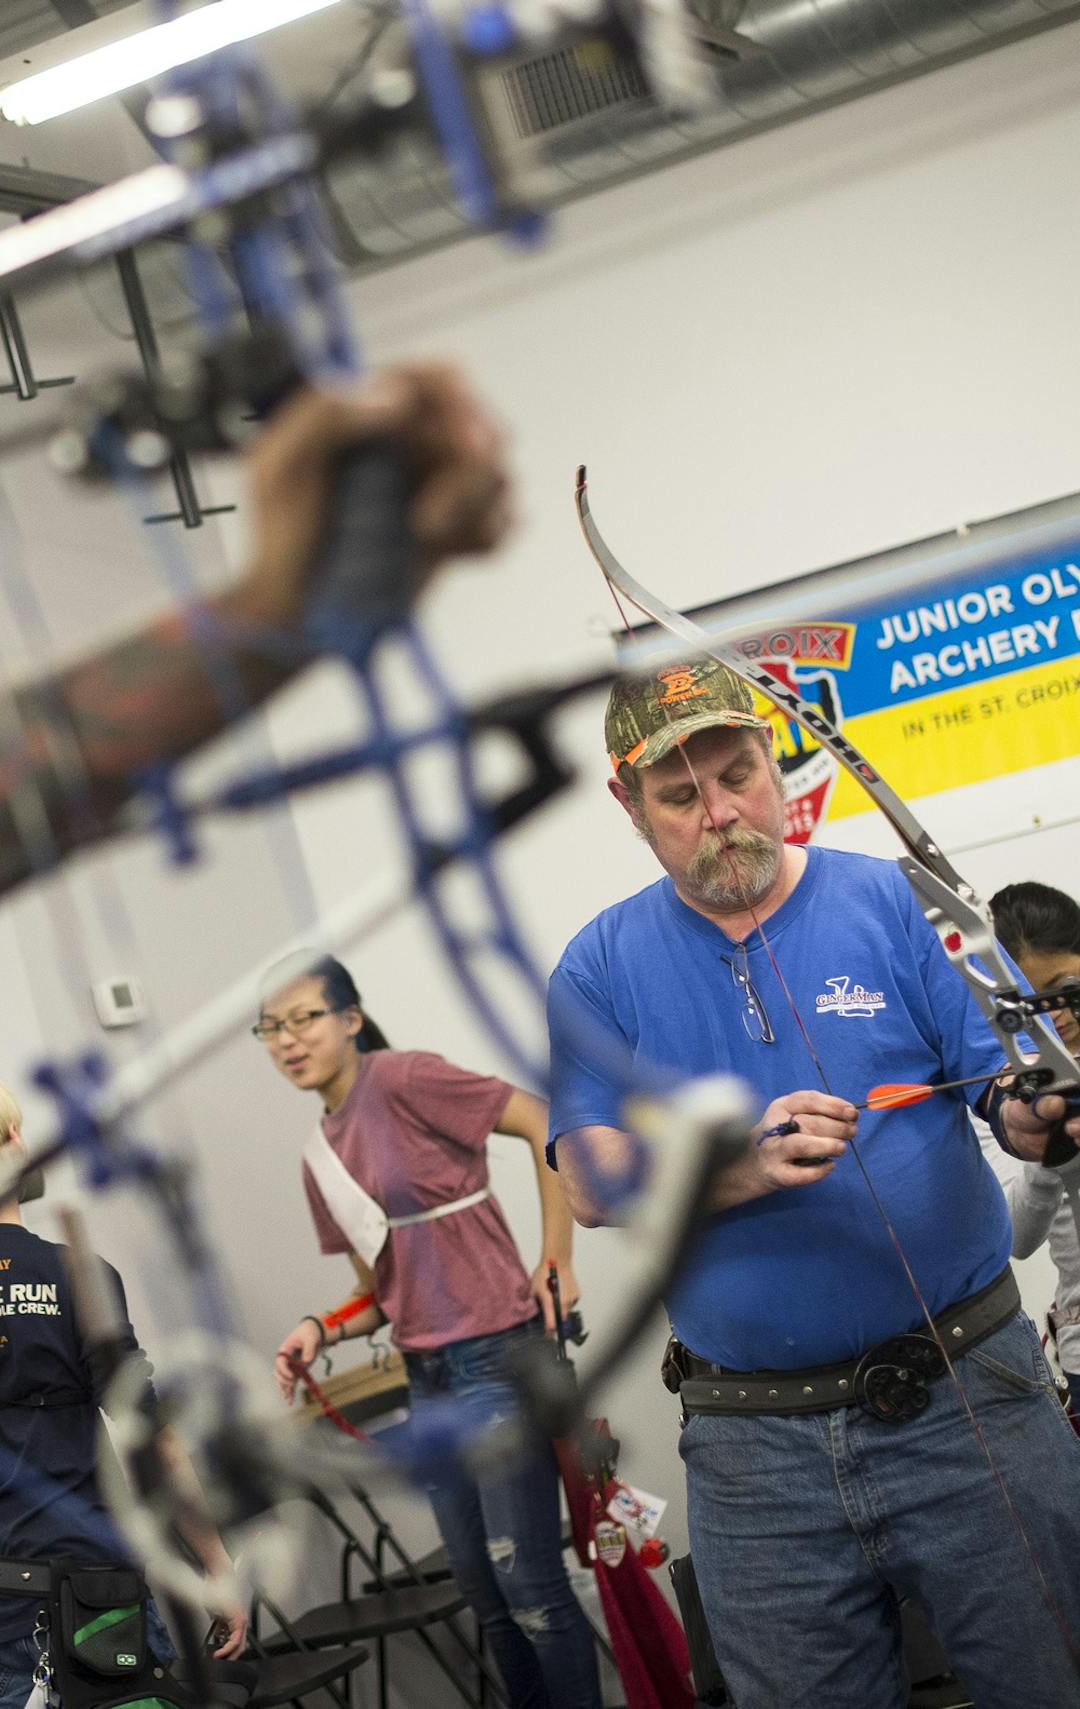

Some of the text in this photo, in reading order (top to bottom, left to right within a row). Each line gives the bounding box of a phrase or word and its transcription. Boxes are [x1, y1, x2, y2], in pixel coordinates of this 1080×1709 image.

[877, 584, 1015, 649] JUNIOR
[740, 629, 842, 660] ROIX
[890, 615, 1059, 693] ARCHERY
[747, 671, 861, 767] HOYT
[902, 719, 924, 739] IN
[932, 704, 971, 731] THE
[10, 1284, 57, 1302] RUN
[18, 1302, 61, 1316] CREW.
